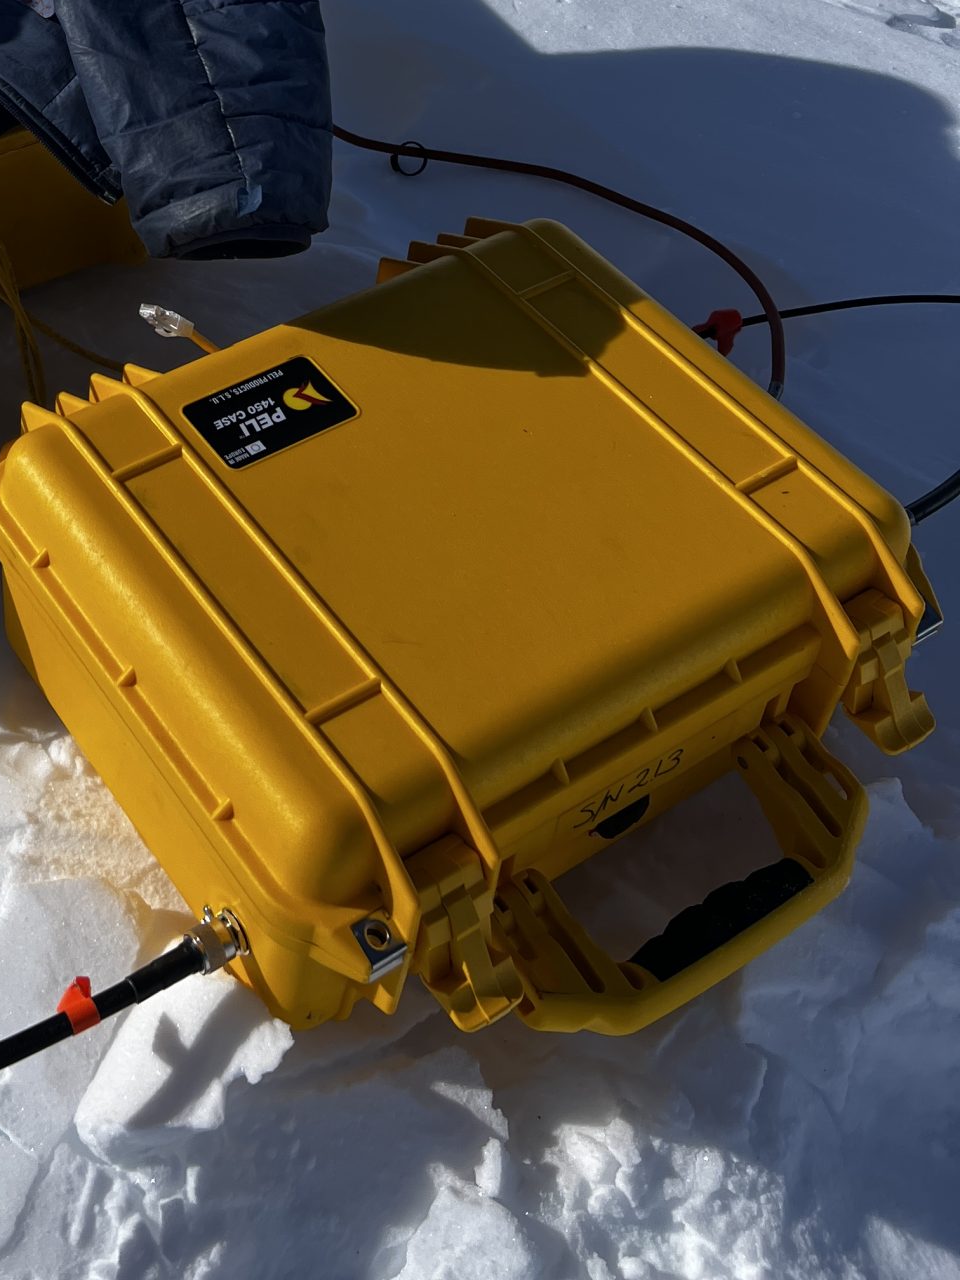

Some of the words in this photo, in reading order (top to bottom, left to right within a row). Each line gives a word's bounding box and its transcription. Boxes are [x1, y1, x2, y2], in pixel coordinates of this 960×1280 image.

[267, 369, 283, 381] PELI
[247, 397, 275, 414] 1450
[213, 410, 246, 430] CASE
